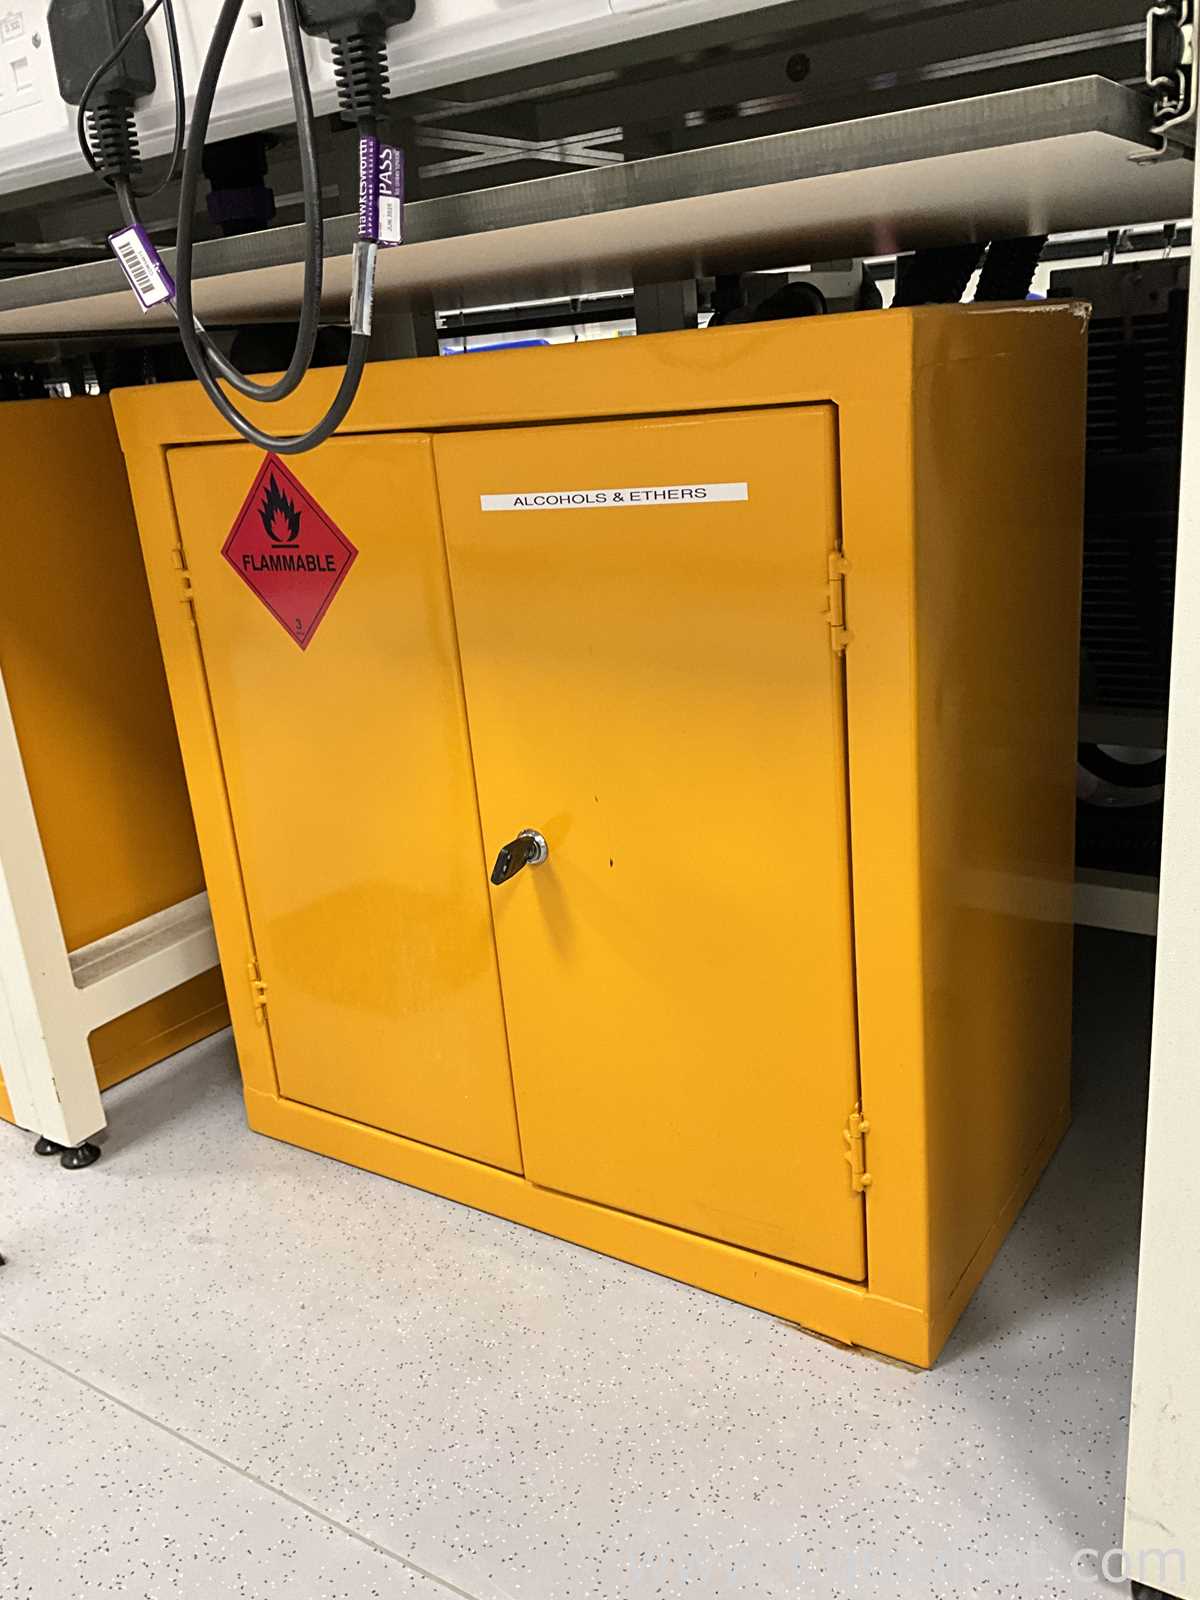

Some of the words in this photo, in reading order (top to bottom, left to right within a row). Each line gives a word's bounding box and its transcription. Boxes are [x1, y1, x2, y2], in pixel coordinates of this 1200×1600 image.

[379, 148, 392, 195] PASS
[513, 492, 607, 506] ALCOHOLS
[612, 491, 625, 503] &
[630, 487, 707, 502] ETHERS
[242, 553, 337, 572] FLAMMABLE
[295, 618, 302, 630] 3
